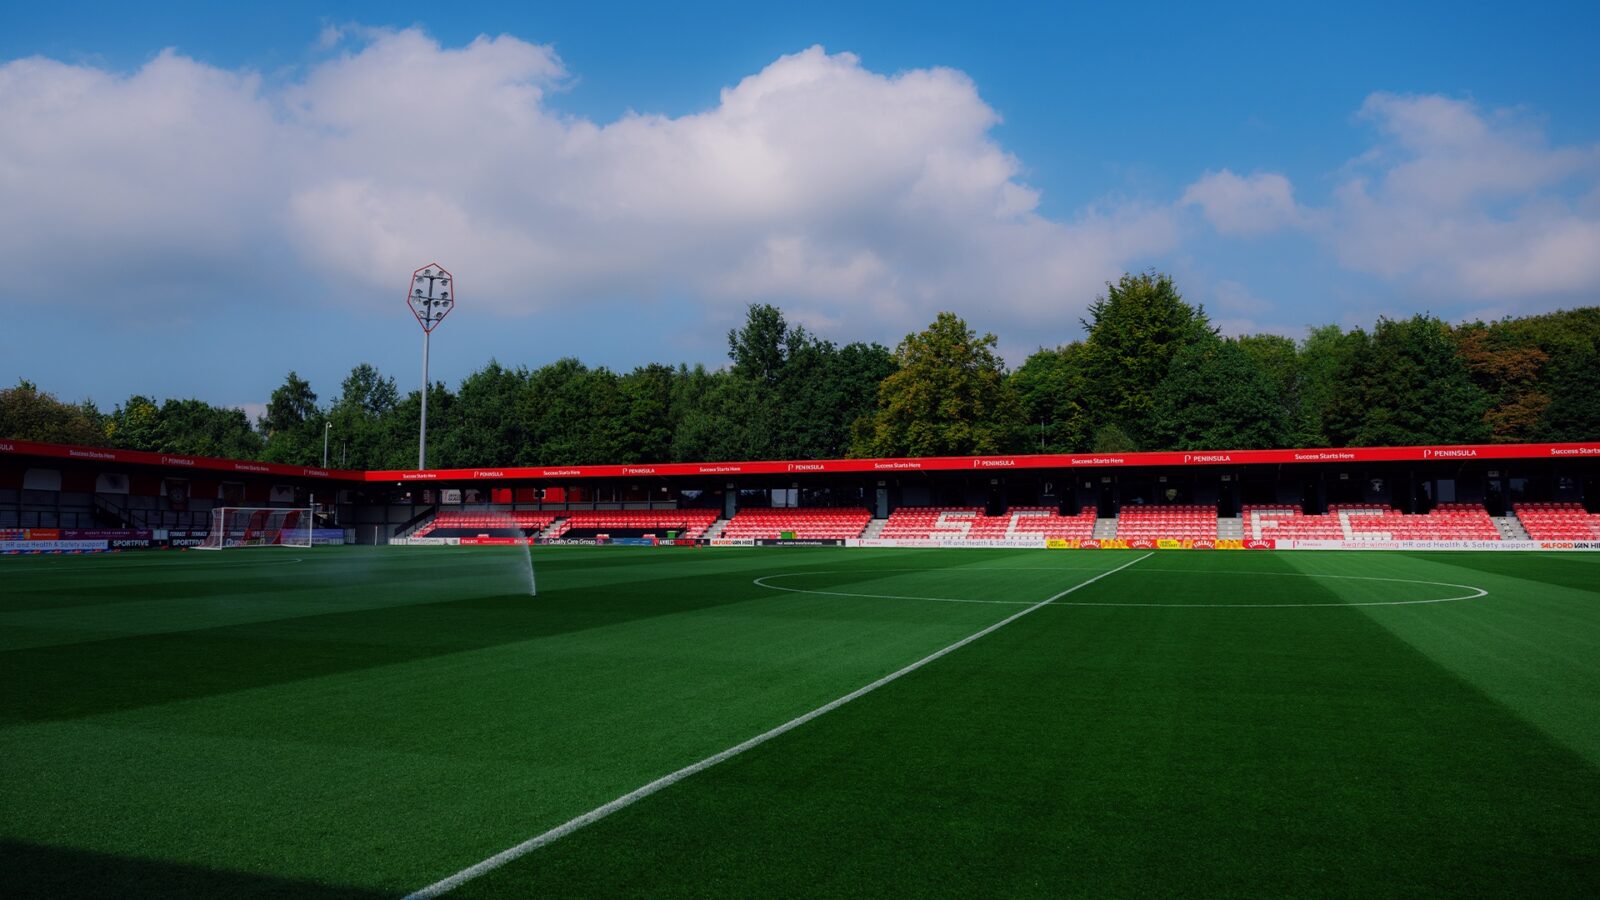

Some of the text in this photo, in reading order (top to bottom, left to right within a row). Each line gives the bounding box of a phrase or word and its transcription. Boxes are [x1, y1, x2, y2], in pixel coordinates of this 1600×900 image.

[1251, 510, 1294, 540] F
[1080, 540, 1100, 548] FIREBALL
[1132, 540, 1153, 548] FIREBALL
[1193, 540, 1215, 548] FIREBALL
[1248, 540, 1271, 548] FIREBALL
[1341, 541, 1399, 549] Award-winning
[1471, 541, 1498, 549] Safety
